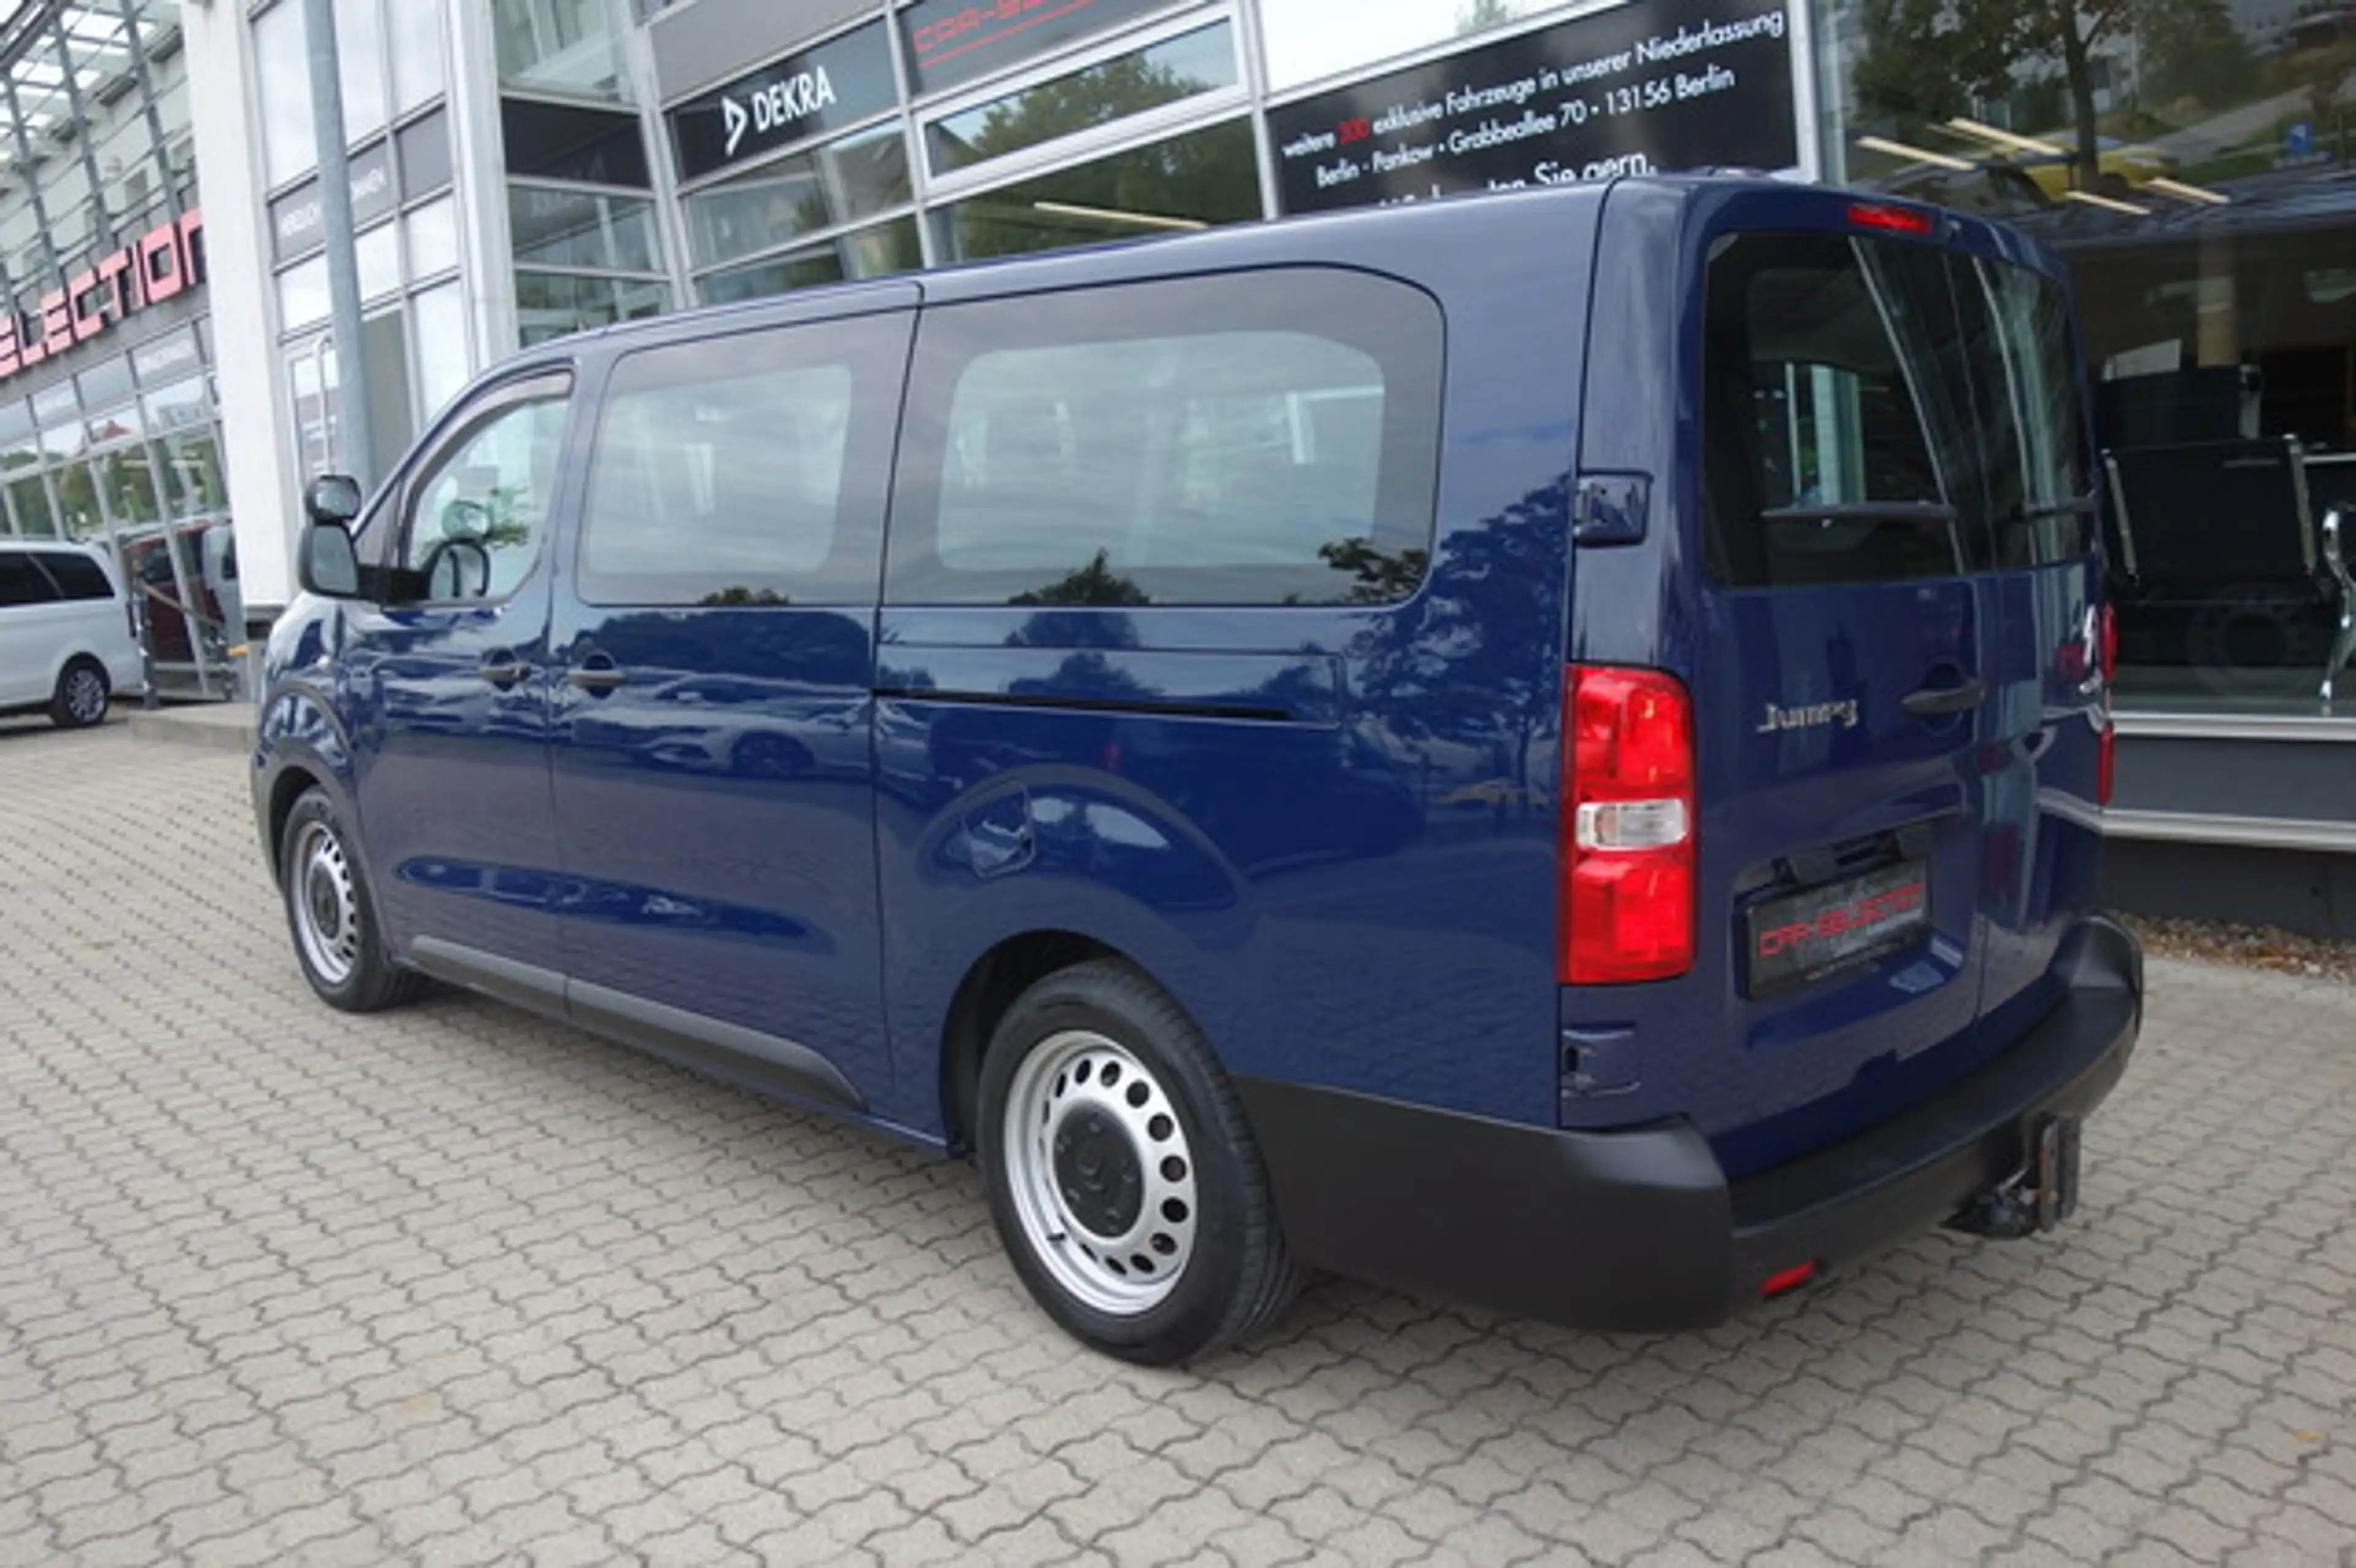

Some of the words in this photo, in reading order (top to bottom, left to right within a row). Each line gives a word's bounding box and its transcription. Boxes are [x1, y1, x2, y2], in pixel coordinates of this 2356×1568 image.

[752, 65, 837, 134] DEKRA
[1282, 133, 1336, 158] weitere
[1372, 98, 1444, 134] exklusive
[1445, 83, 1536, 115] Fahrzeuge
[1538, 66, 1558, 91] in
[1561, 51, 1632, 86] unserer
[1634, 10, 1784, 65] Niederlassung
[1315, 157, 1360, 189] Berlin
[1372, 142, 1434, 173] Pankow
[1447, 109, 1557, 155] Grabbeallee
[1559, 99, 1588, 128] 70
[1605, 78, 1673, 115] 13156
[1674, 63, 1736, 100] Berlin
[1534, 161, 1576, 185] Sie
